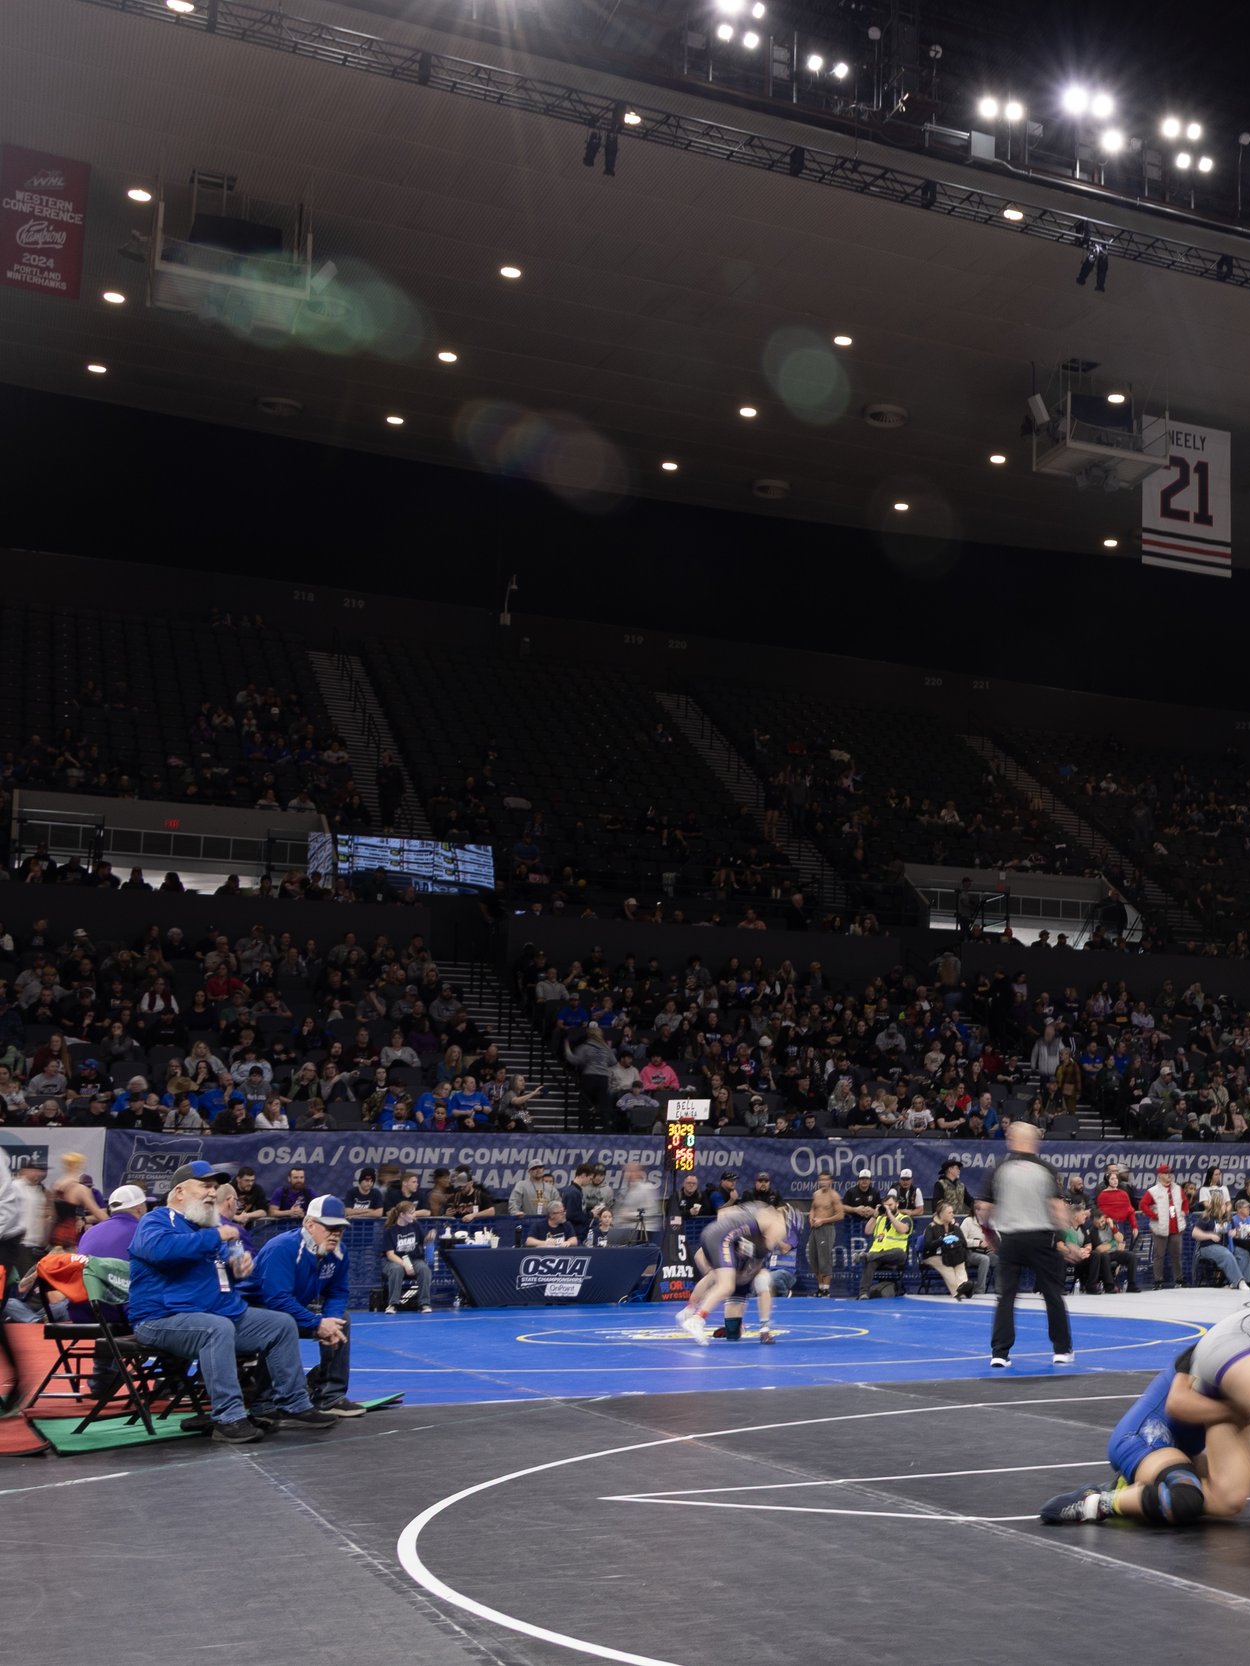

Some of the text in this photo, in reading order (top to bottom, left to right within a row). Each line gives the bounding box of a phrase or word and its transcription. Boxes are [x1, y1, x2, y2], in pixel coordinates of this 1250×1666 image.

[2, 198, 84, 225] CONFERENCE
[16, 190, 73, 212] WESTERN
[16, 219, 67, 249] Champions
[22, 253, 55, 269] 2024
[6, 270, 67, 291] WINTERHAWKS
[14, 264, 62, 281] PORTLAND
[1168, 429, 1206, 452] NEELY
[1160, 455, 1213, 527] 21
[676, 1102, 695, 1111] BELL
[257, 1146, 324, 1165] OSAA
[349, 1146, 455, 1165] ONPOINT
[458, 1147, 595, 1166] COMMUNITY
[597, 1149, 665, 1167] CREDI
[693, 1150, 744, 1168] NION
[790, 1146, 905, 1178] OnPoint
[1094, 1154, 1196, 1170] COMMUNITY
[677, 1234, 687, 1262] 5
[519, 1255, 591, 1277] OSAA
[662, 1264, 694, 1279] MAT
[538, 1276, 583, 1284] CHAMPIONSHIPS
[549, 1284, 575, 1292] OnPoint
